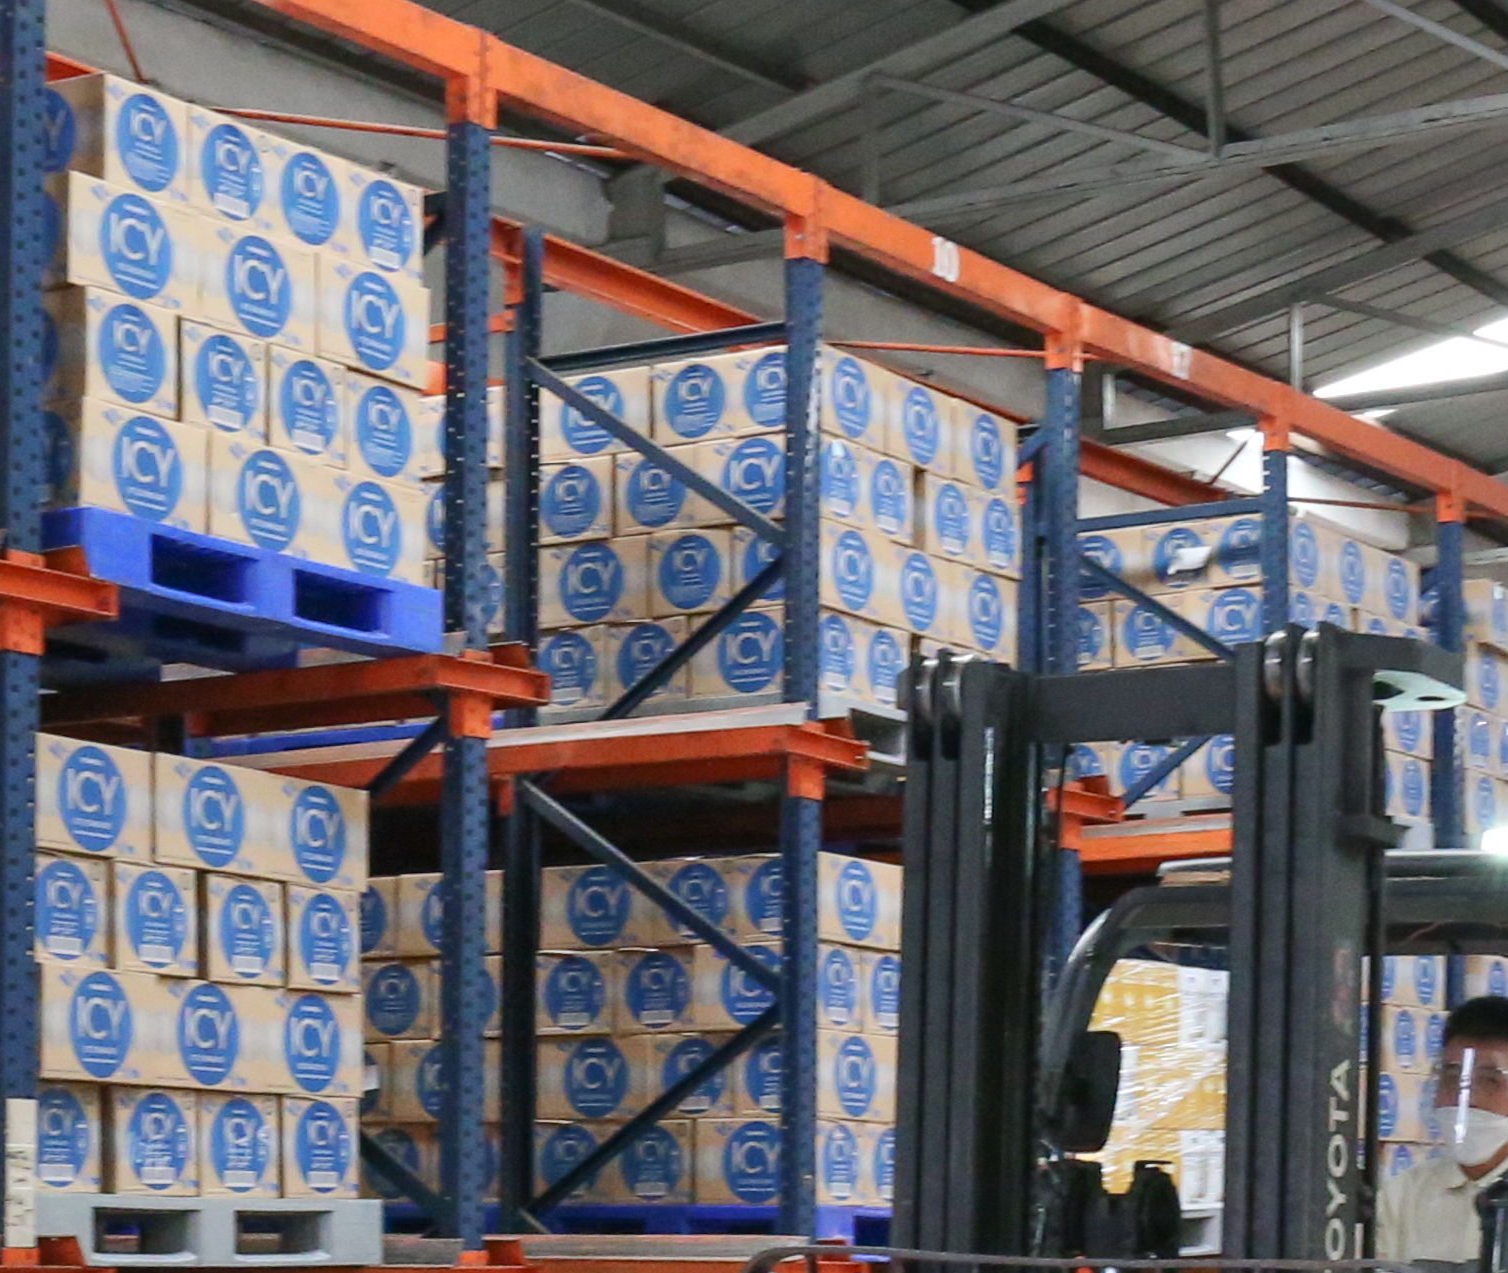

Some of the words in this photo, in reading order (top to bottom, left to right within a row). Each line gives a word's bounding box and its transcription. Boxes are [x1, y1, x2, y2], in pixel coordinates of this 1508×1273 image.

[129, 112, 164, 142] ICY
[214, 140, 252, 173] ICY
[292, 169, 326, 198] ICY
[370, 196, 402, 225] ICY
[109, 212, 164, 262] ICY
[234, 254, 286, 302] ICY
[351, 289, 401, 337] ICY
[113, 322, 150, 353] ICY
[209, 350, 245, 381] ICY
[291, 377, 325, 406] ICY
[368, 403, 399, 430] ICY
[122, 438, 177, 486] ICY
[245, 470, 295, 517] ICY
[349, 500, 397, 545] ICY
[68, 772, 120, 813] ICY
[191, 789, 240, 830] ICY
[298, 808, 340, 847] ICY
[46, 879, 82, 908] ICY
[139, 886, 173, 918] ICY
[230, 902, 263, 929] ICY
[309, 912, 341, 938] ICY
[77, 995, 127, 1039] ICY
[185, 1008, 234, 1049] ICY
[290, 1019, 333, 1057] ICY
[307, 1116, 340, 1146] ICY
